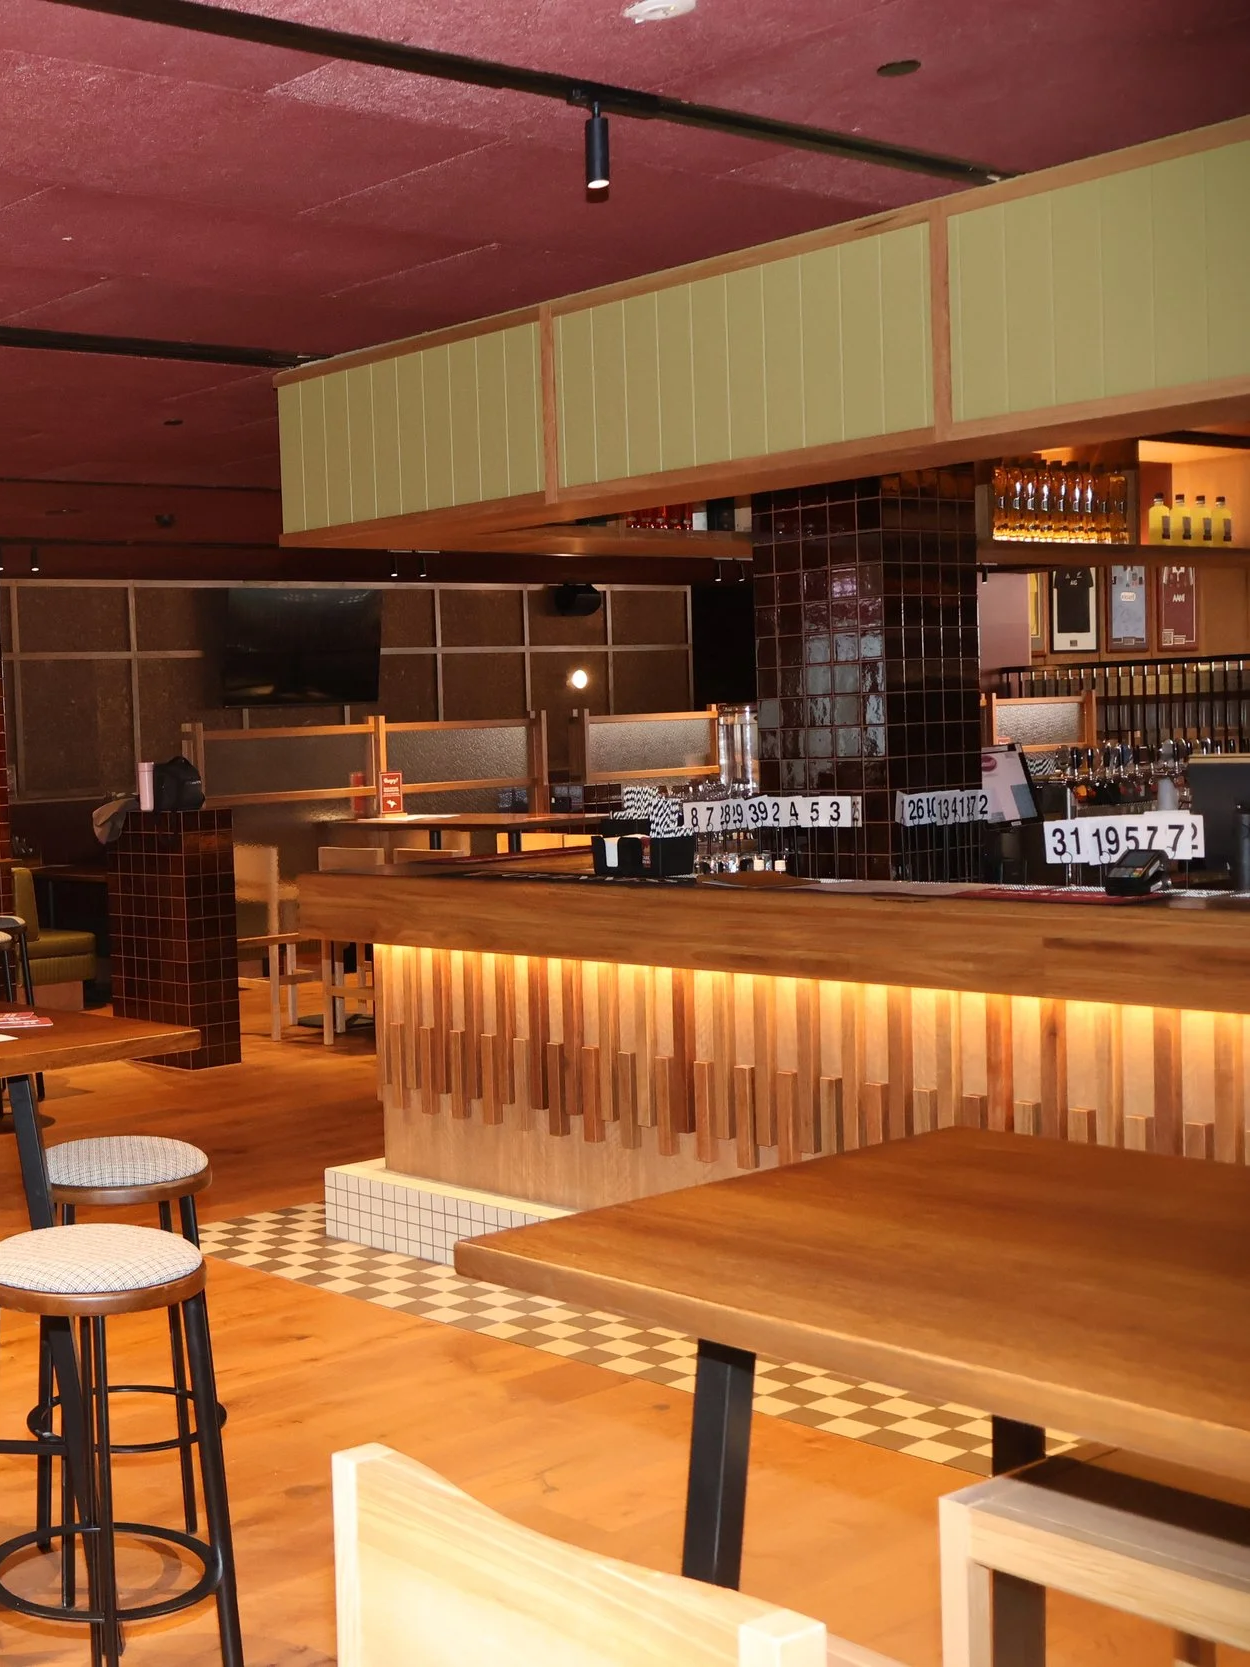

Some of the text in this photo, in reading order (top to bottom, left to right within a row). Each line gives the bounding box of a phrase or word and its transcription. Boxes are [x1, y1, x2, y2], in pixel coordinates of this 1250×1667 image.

[691, 807, 699, 826] 8
[706, 807, 714, 826] 7
[748, 801, 768, 823] 39
[772, 802, 780, 822] 2
[790, 802, 799, 821] 4
[810, 802, 819, 821] 5
[829, 801, 841, 822] 3
[908, 798, 924, 820] 26
[938, 799, 950, 820] 13
[979, 795, 988, 815] 2
[1052, 827, 1081, 856] 31
[1092, 826, 1120, 856] 19
